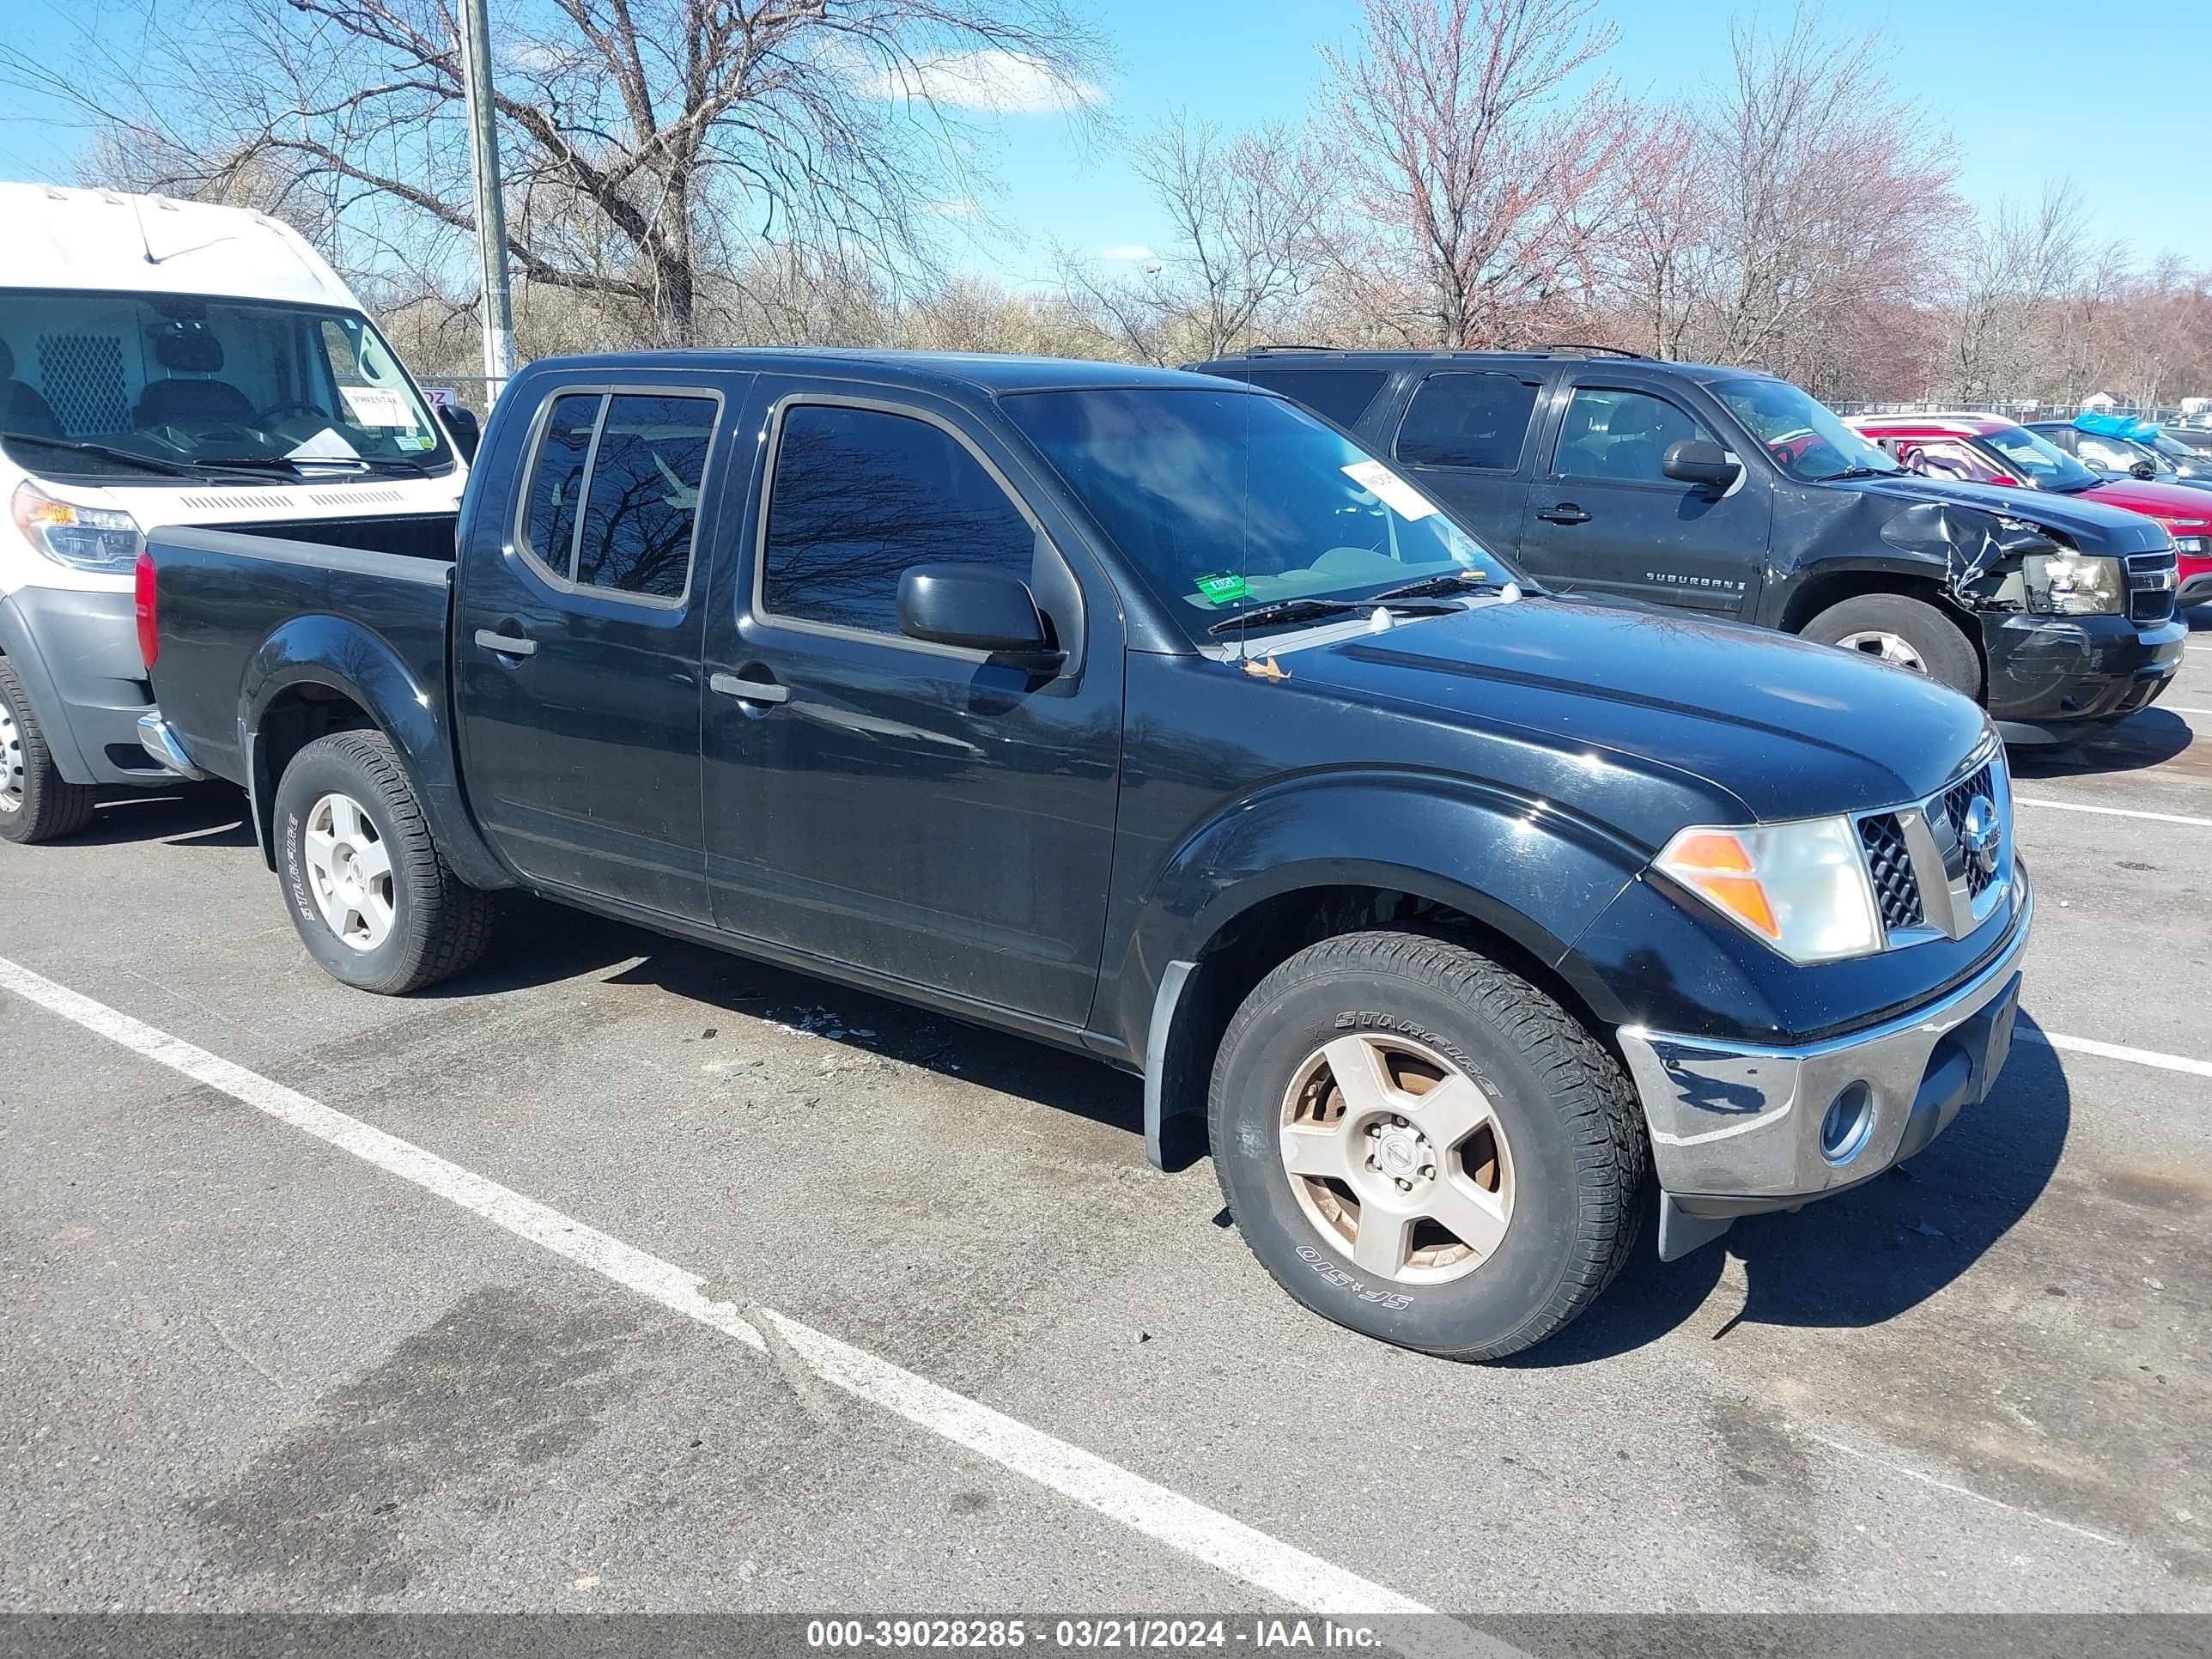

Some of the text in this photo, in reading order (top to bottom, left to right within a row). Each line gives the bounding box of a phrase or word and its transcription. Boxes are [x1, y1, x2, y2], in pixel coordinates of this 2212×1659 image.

[1213, 579, 1232, 589] AUG
[1645, 572, 1734, 589] SUBURBAN
[286, 812, 315, 921] STARFIRE
[1334, 1011, 1504, 1099] STARFIRE
